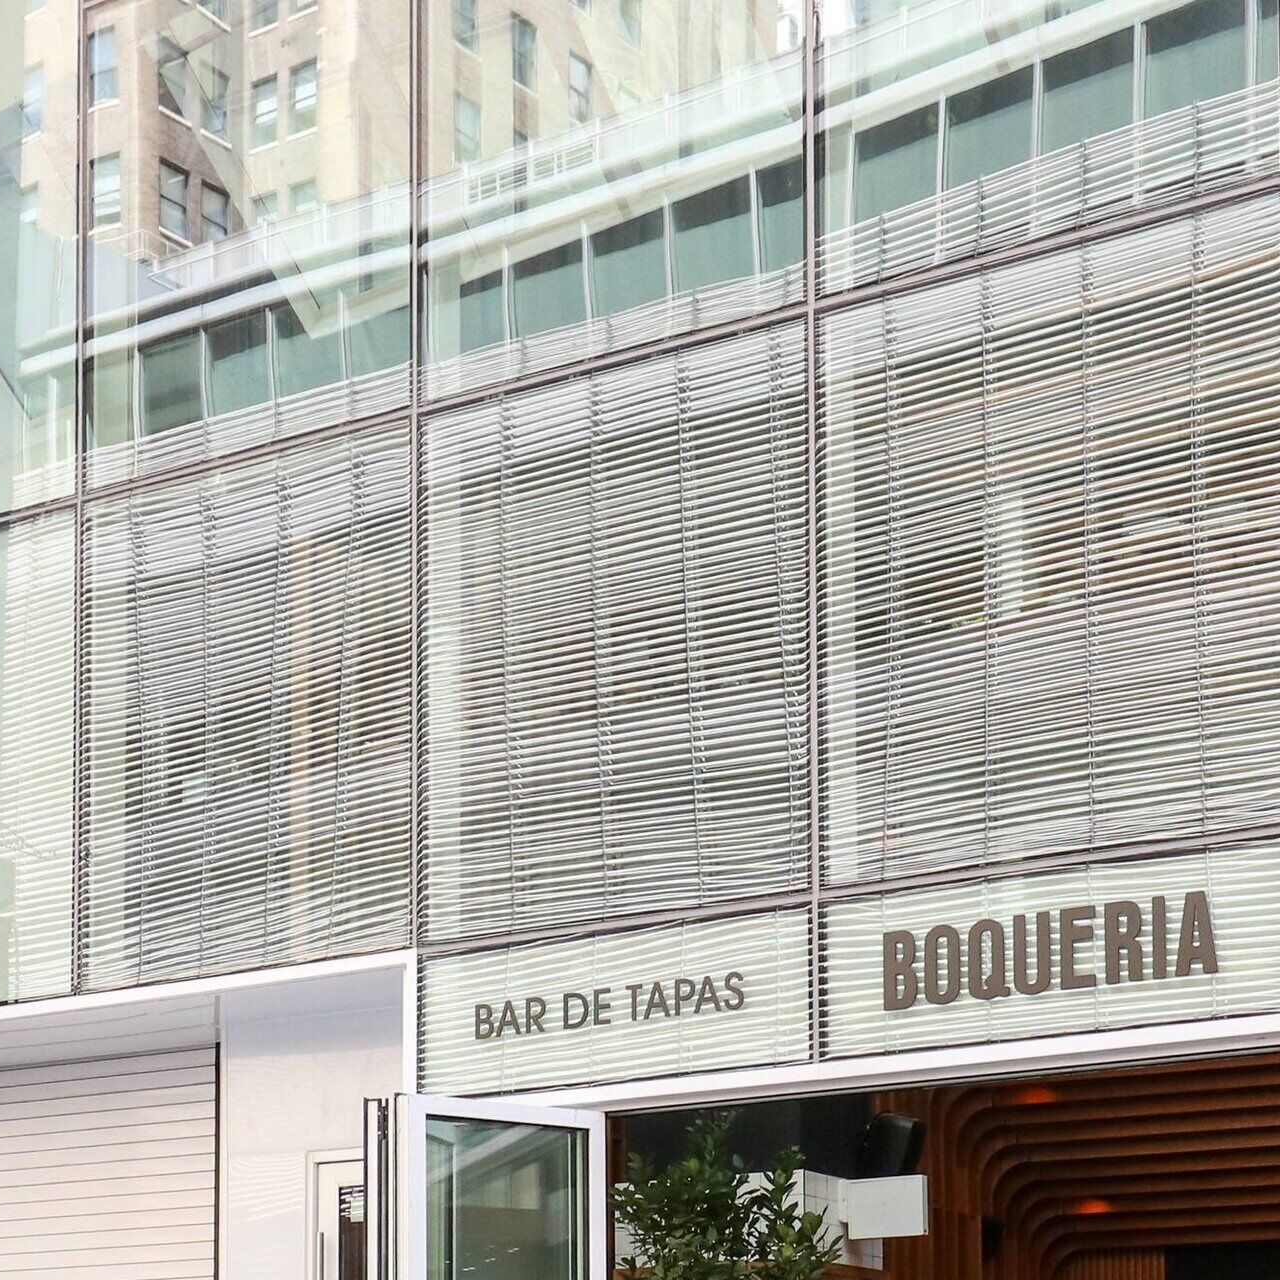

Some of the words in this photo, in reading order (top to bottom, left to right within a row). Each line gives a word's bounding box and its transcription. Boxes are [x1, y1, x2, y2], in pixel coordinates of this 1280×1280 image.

[883, 890, 1218, 1011] BOQUERIA
[474, 996, 547, 1040] BAR
[563, 987, 612, 1030] DE
[625, 971, 745, 1021] TAPAS
